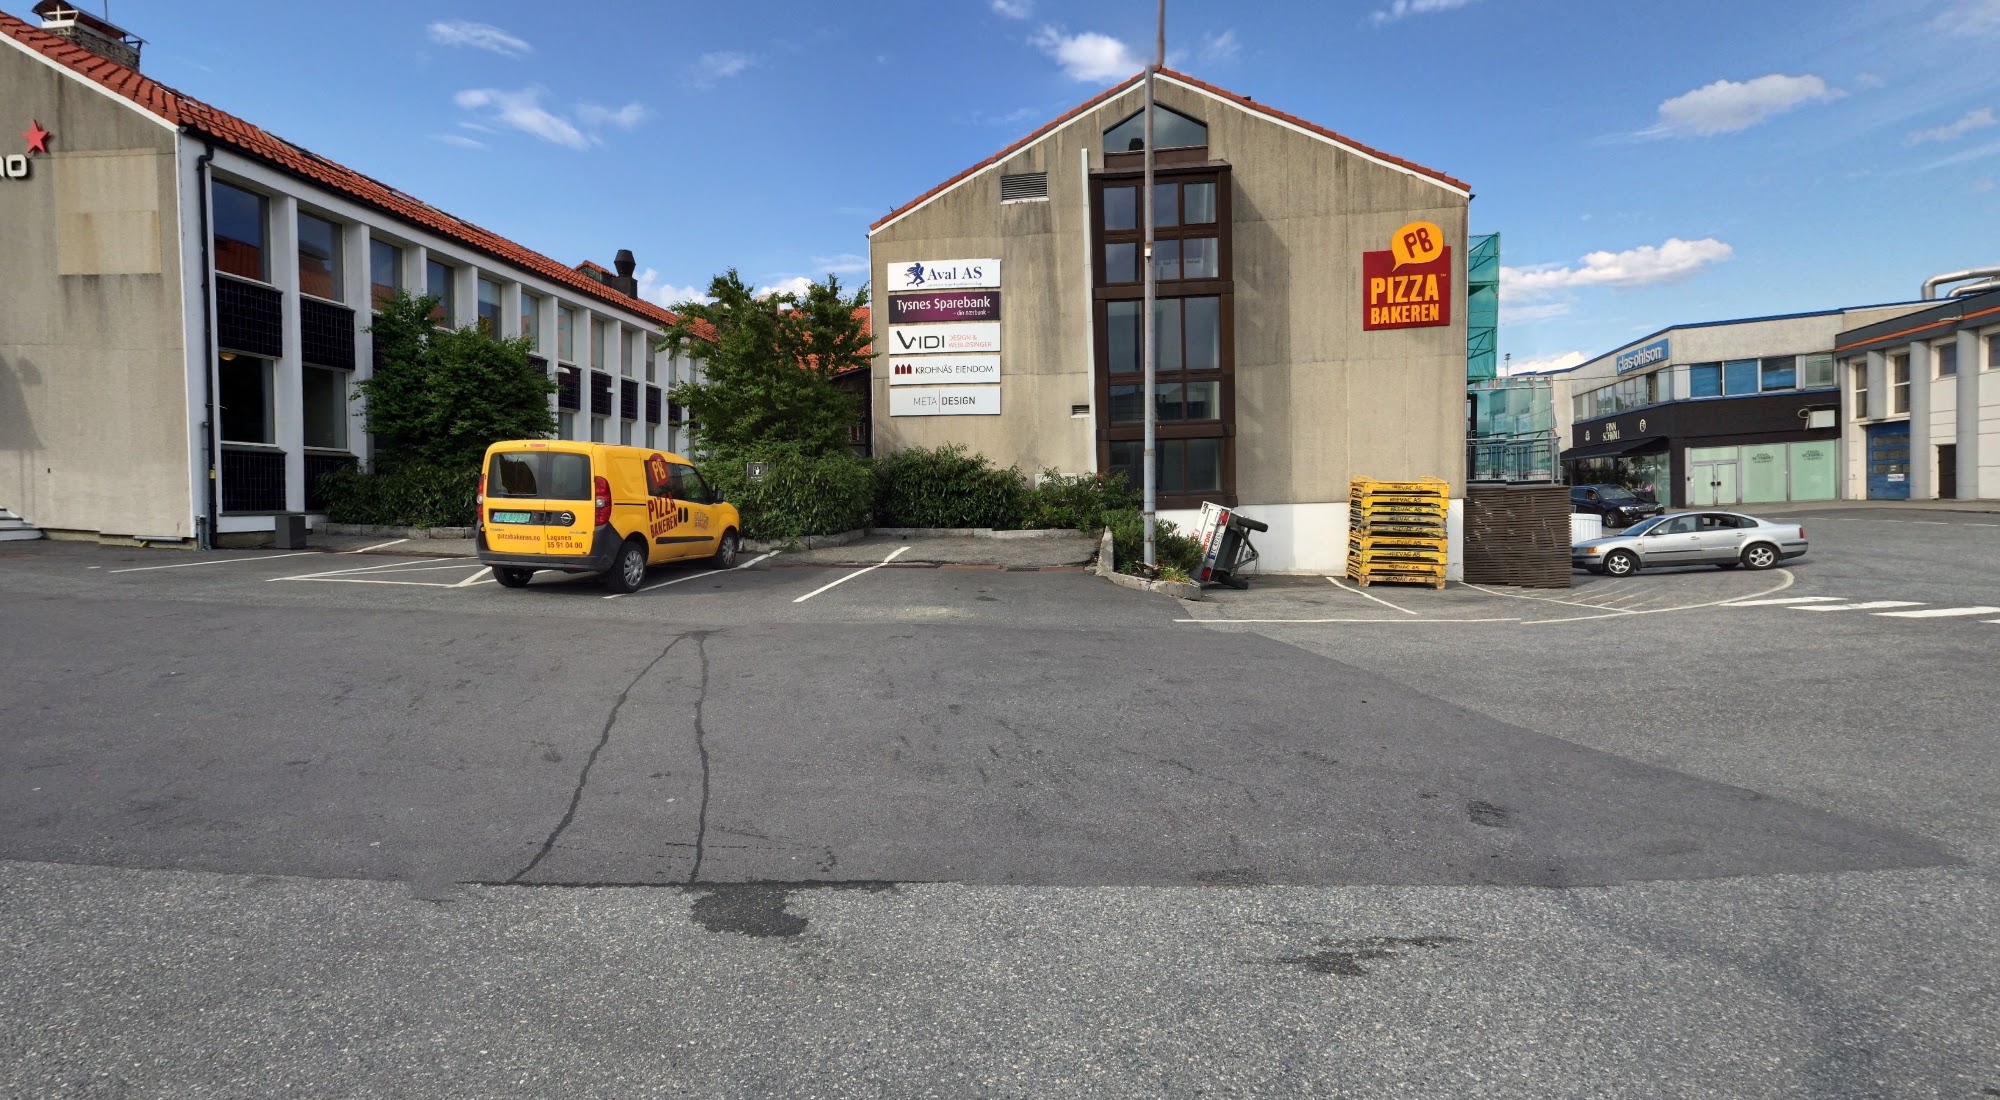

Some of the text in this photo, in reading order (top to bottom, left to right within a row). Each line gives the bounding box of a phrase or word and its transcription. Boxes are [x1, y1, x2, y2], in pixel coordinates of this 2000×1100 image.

[0, 154, 27, 178] o
[1404, 228, 1434, 258] PB
[927, 266, 982, 281] Aval AS
[1370, 274, 1439, 304] PIZZA
[896, 296, 990, 313] Tysnes Sparebank
[1370, 304, 1439, 325] BAKEREN
[896, 330, 945, 350] VIDI
[916, 364, 952, 374] KROHNÅS
[913, 396, 976, 406] META DESIGN
[1606, 422, 1617, 432] FINN
[652, 458, 666, 482] PB
[648, 492, 676, 522] PIZZA
[650, 514, 678, 538] BAKEREN
[497, 533, 540, 542] pizzabakeren.no
